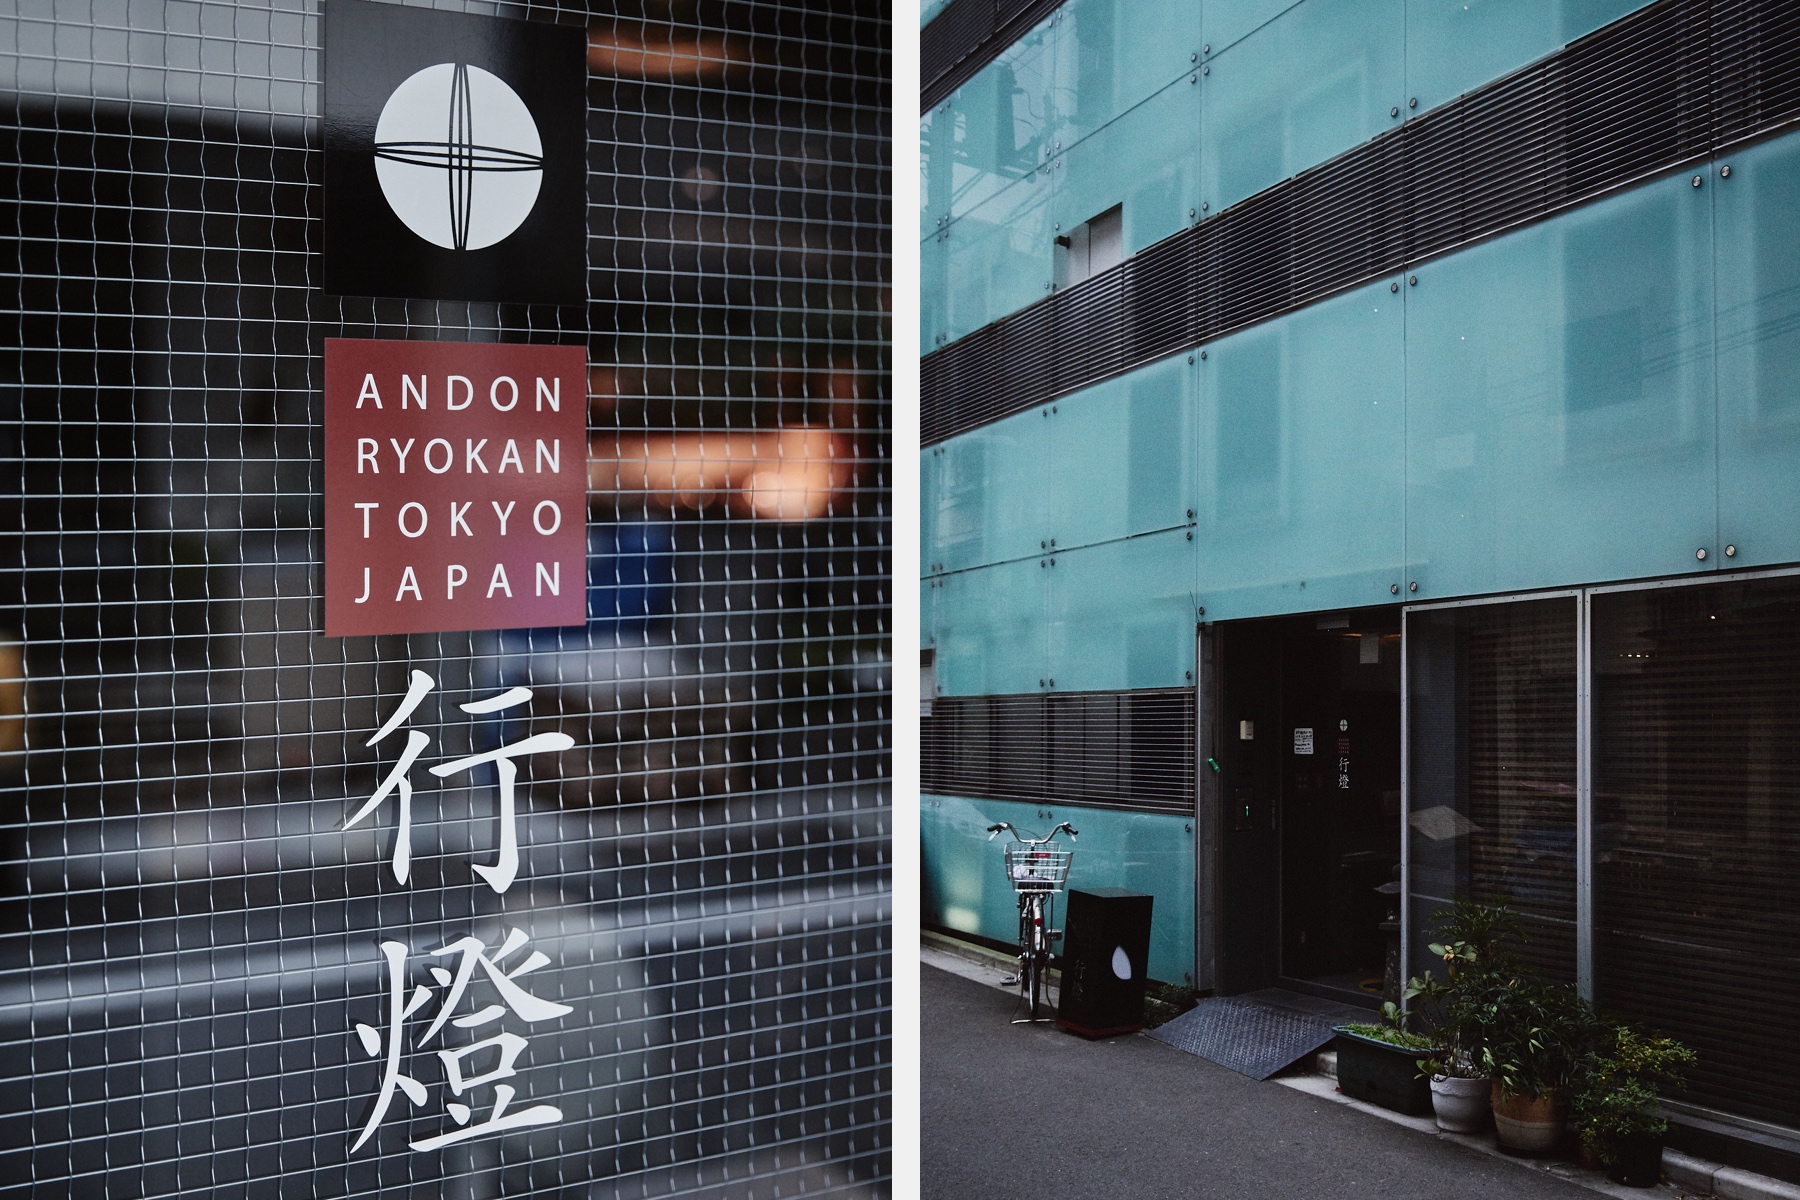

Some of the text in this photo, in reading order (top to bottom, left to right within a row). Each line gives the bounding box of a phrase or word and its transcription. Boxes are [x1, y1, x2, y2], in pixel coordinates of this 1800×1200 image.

[356, 373, 560, 412] ANDON
[357, 438, 560, 474] RYOKAN
[354, 500, 562, 538] TOKYO
[354, 561, 560, 604] JAPAN
[341, 669, 576, 1154] 行燈
